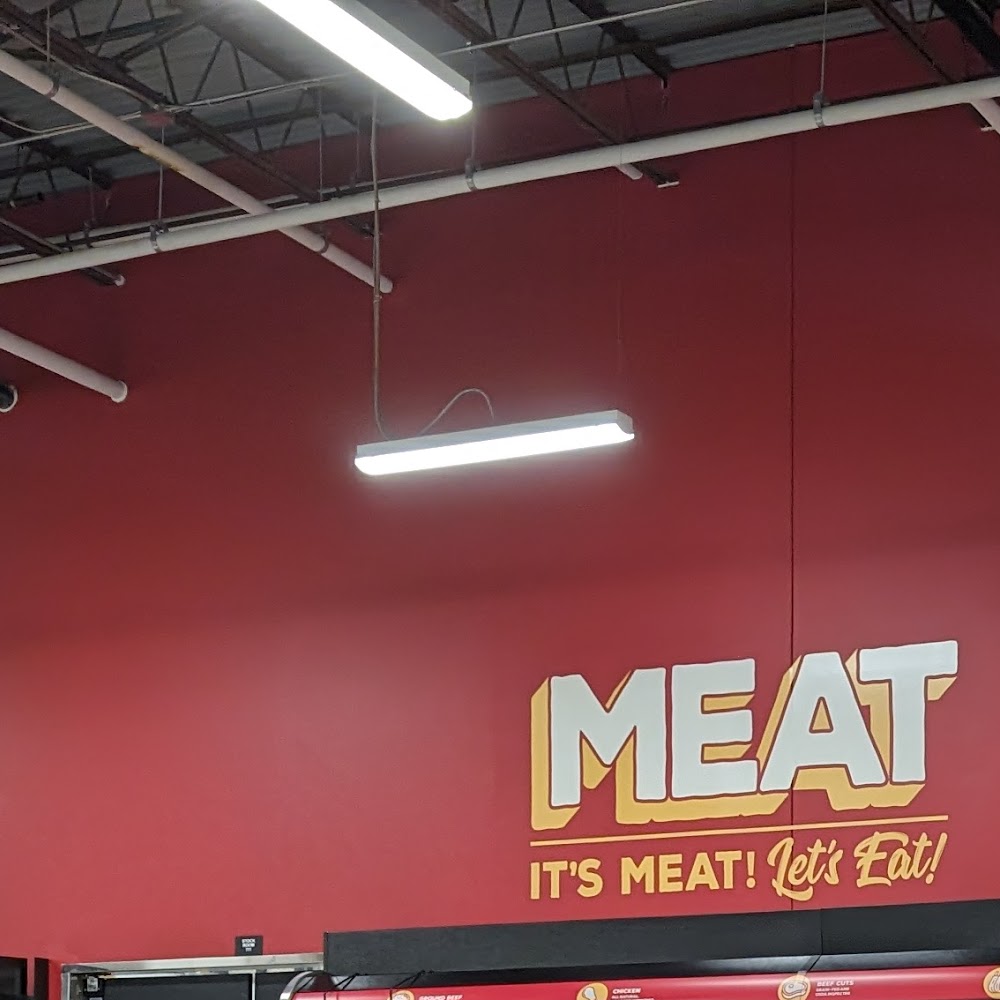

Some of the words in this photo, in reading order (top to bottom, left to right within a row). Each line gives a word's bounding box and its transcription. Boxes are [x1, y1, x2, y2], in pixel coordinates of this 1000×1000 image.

[530, 640, 958, 830] MEAT
[530, 859, 603, 900] IT'S
[620, 850, 756, 895] MEAT!
[766, 836, 845, 901] Let's
[854, 831, 948, 888] Eat!
